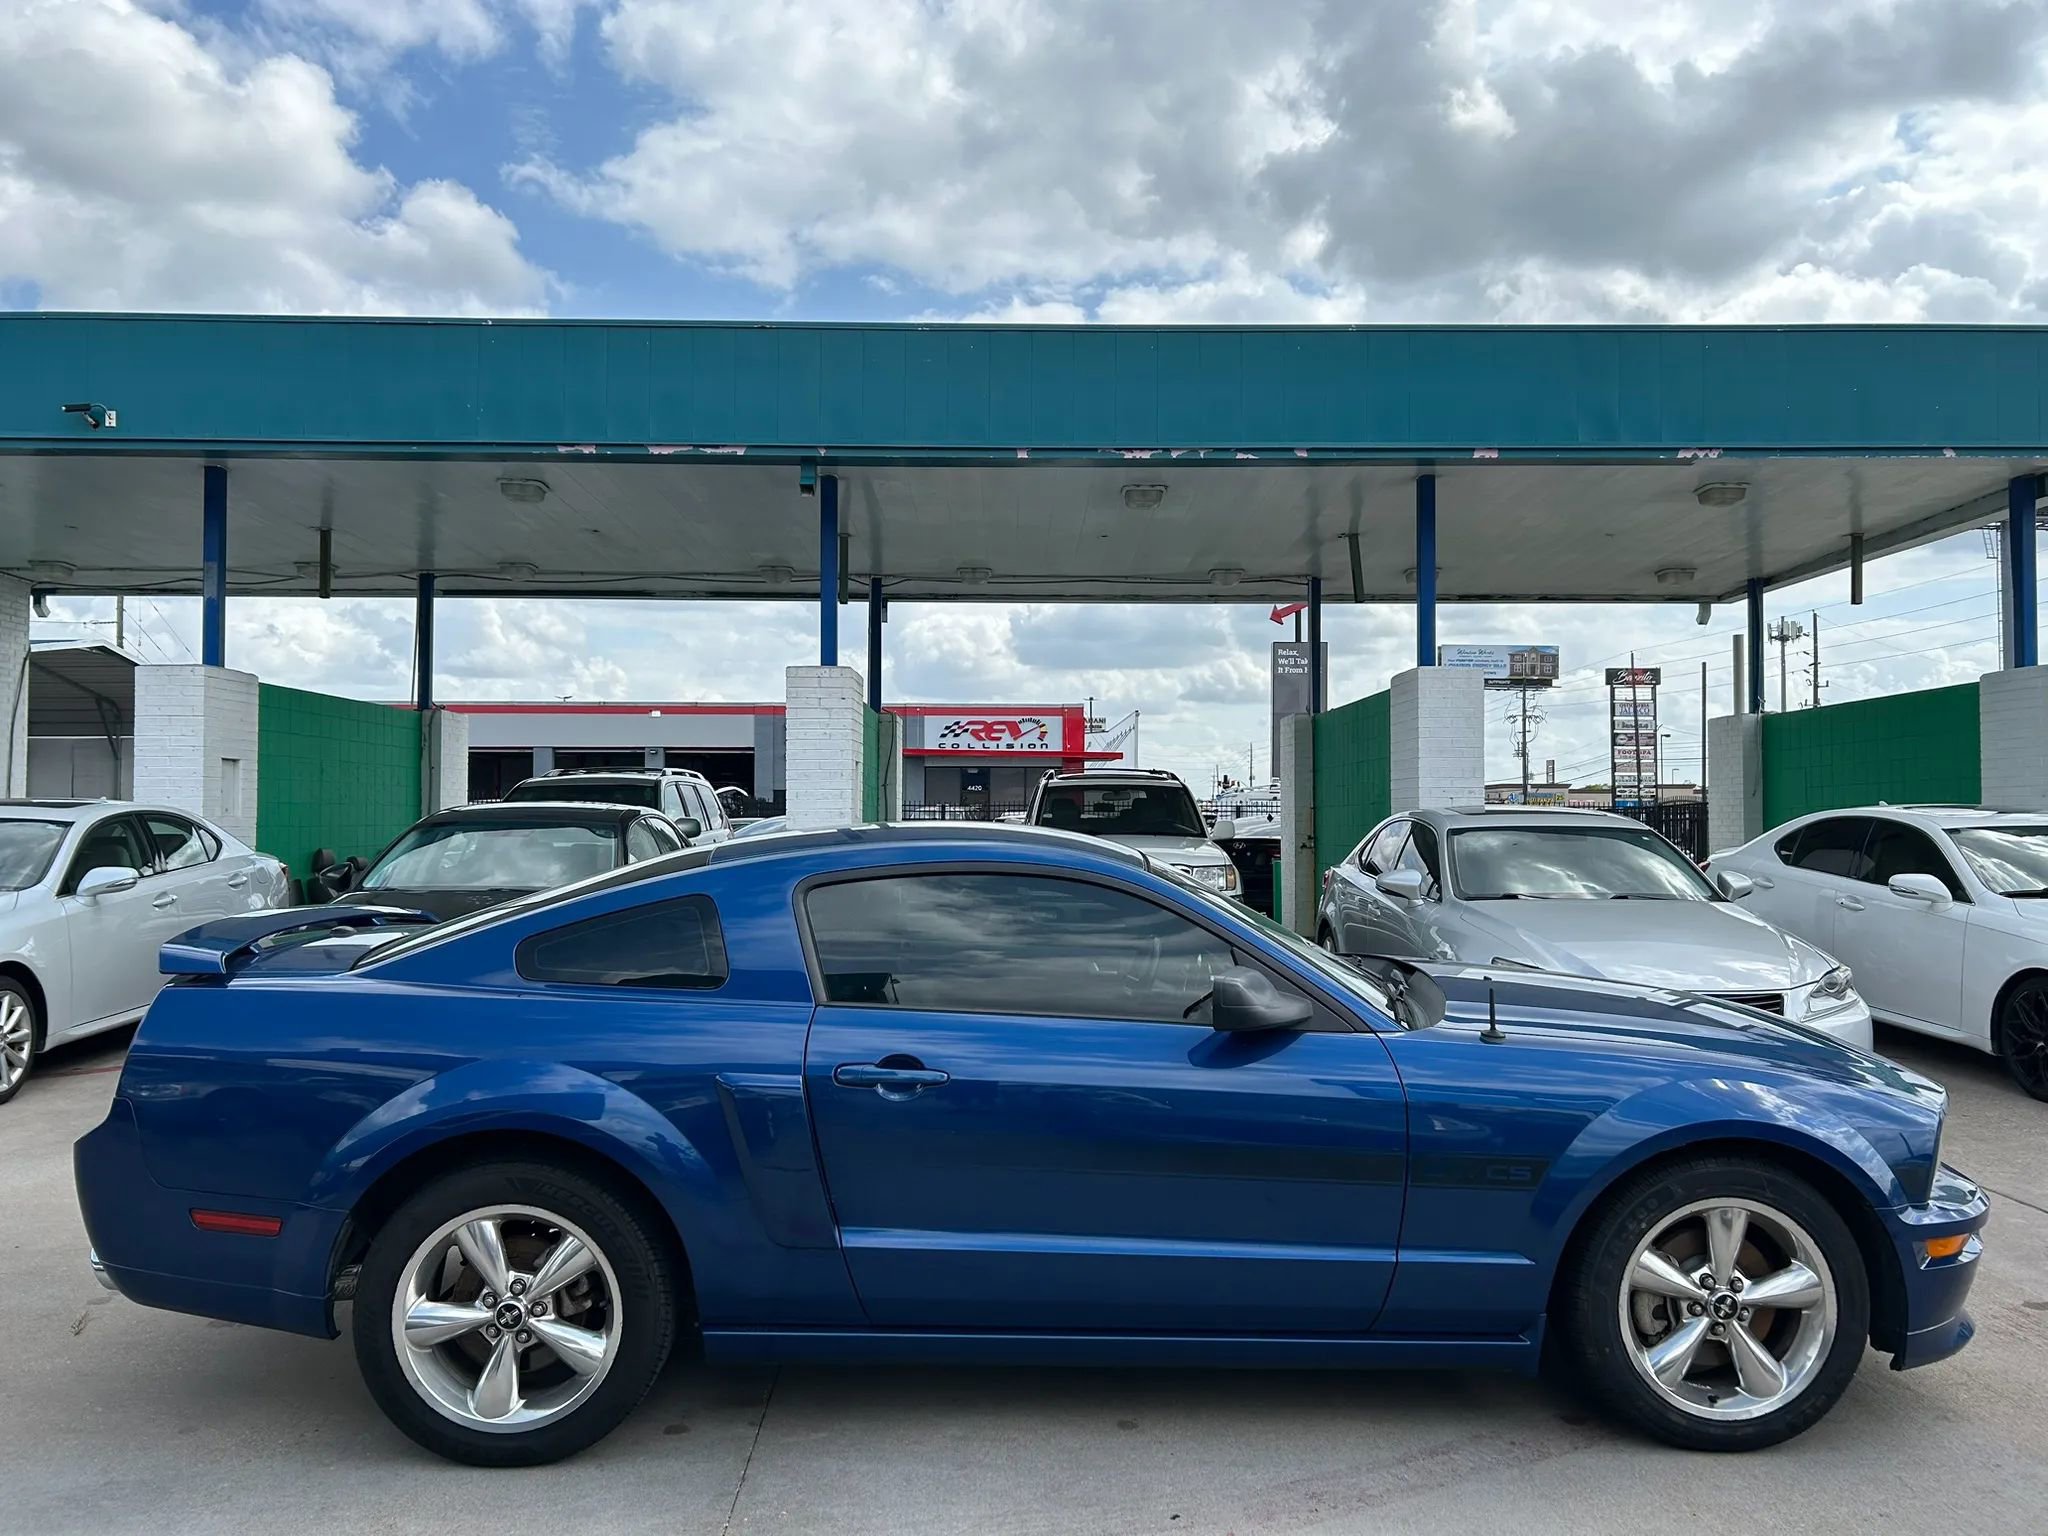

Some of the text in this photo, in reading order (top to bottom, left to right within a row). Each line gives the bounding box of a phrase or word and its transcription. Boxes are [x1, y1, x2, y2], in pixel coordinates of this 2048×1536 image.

[1277, 648, 1299, 656] Relax,
[1277, 657, 1295, 665] We'll
[1277, 666, 1284, 674] It
[1285, 666, 1304, 674] From
[1619, 707, 1650, 715] JALCO
[966, 720, 1023, 742] REV
[938, 742, 1049, 750] COLLISION
[1486, 1164, 1533, 1181] CS
